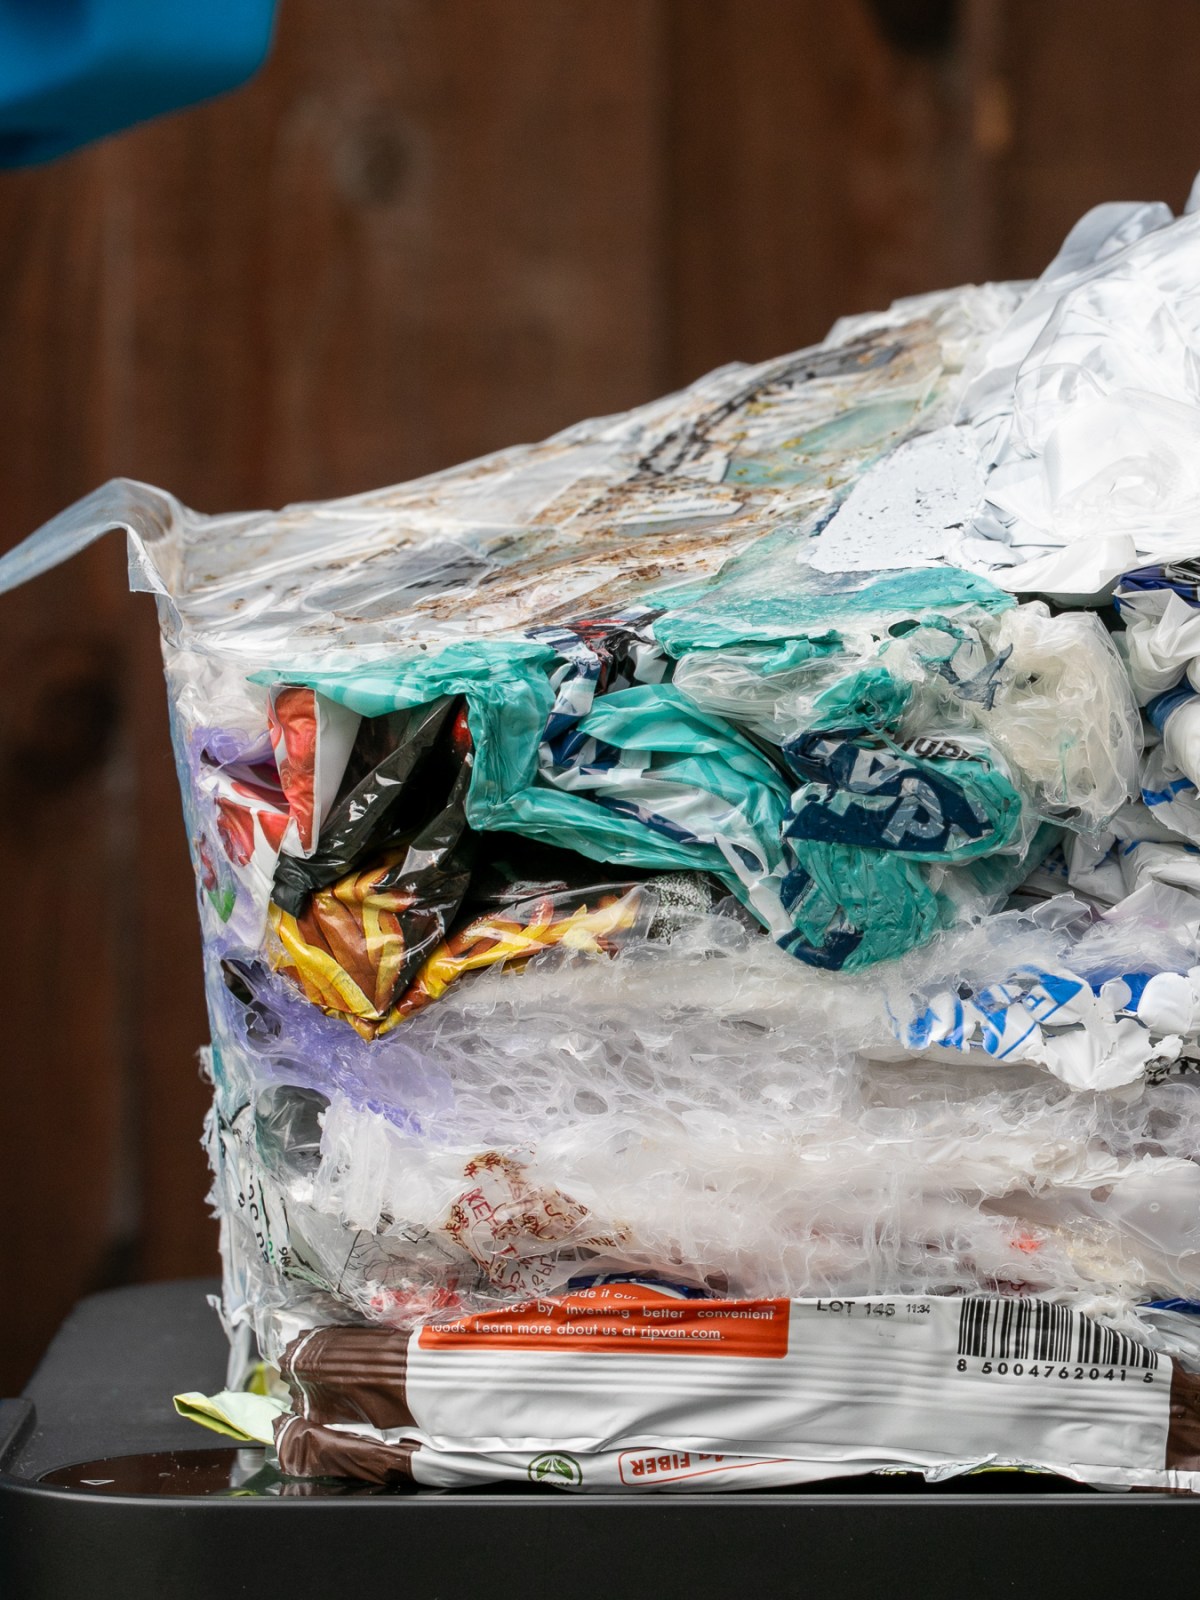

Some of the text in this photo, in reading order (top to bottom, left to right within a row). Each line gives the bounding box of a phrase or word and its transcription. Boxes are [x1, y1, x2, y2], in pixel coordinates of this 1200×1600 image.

[600, 1288, 610, 1299] it
[537, 1300, 554, 1316] by
[566, 1303, 630, 1319] inventing
[643, 1305, 685, 1319] better
[697, 1309, 774, 1320] convenient
[816, 1299, 856, 1314] LOT
[476, 1321, 513, 1334] Learn
[518, 1325, 552, 1335] more
[557, 1322, 598, 1336] about
[602, 1327, 617, 1336] us
[622, 1326, 637, 1337] at
[640, 1327, 726, 1341] ripvan.com.
[630, 1452, 690, 1476] FIBER
